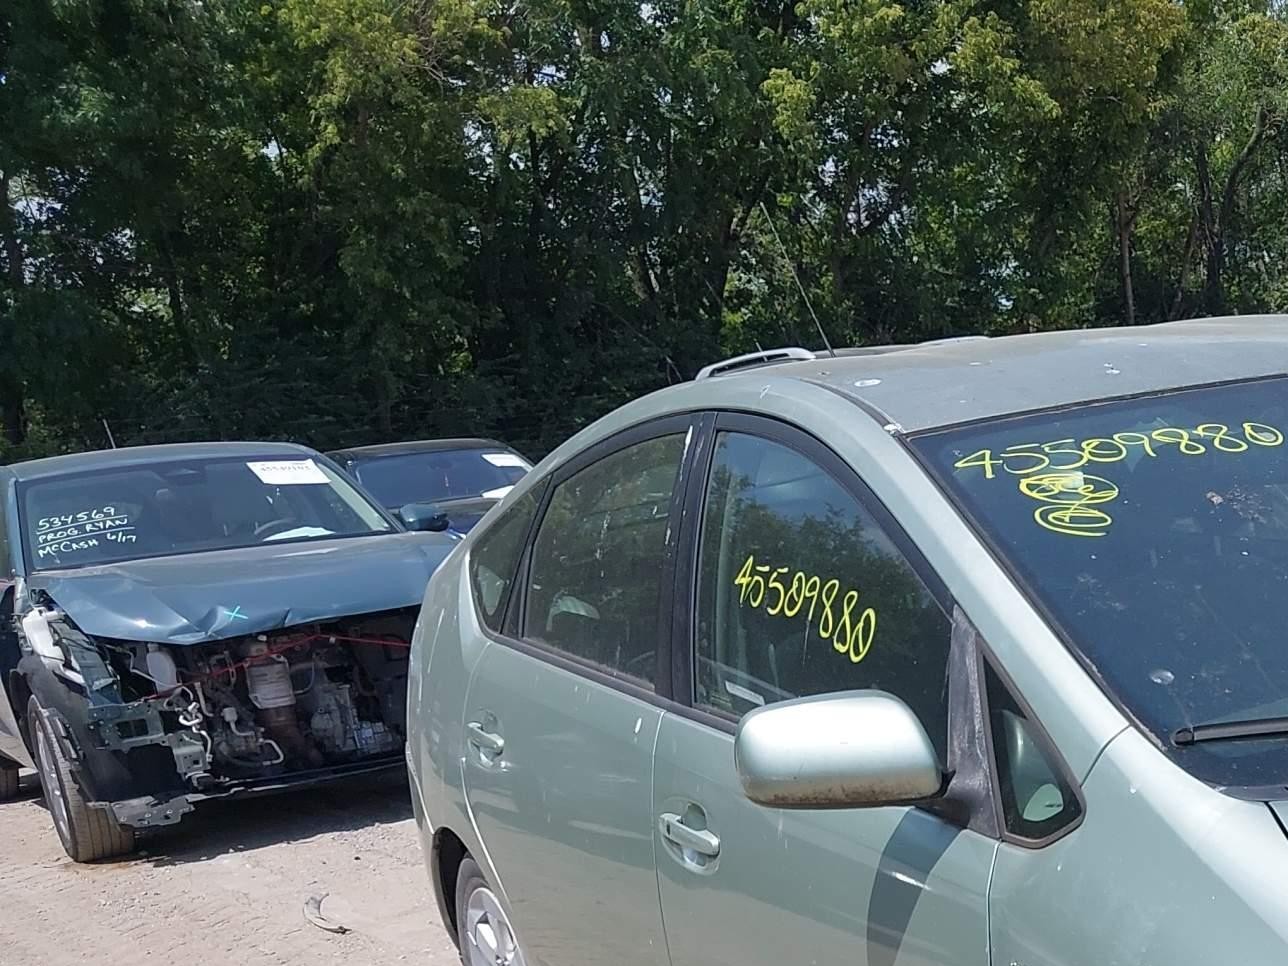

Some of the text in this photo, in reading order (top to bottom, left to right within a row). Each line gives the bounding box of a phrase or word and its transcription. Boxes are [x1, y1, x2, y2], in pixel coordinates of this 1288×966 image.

[954, 422, 1284, 479] 45509880
[37, 506, 115, 531] 534569
[38, 518, 128, 543] PROG. RYAN
[734, 555, 876, 663] 45509880
